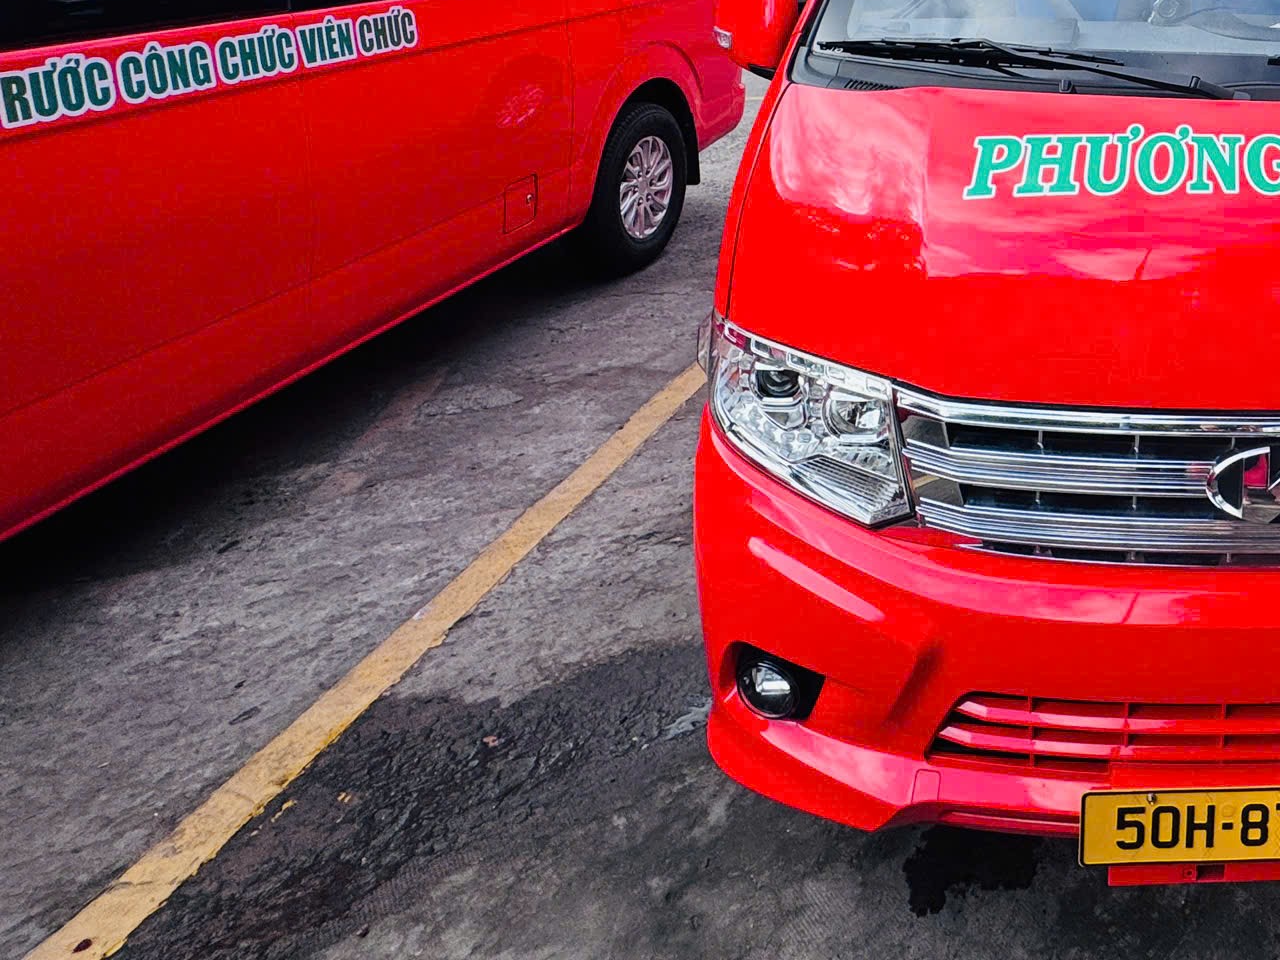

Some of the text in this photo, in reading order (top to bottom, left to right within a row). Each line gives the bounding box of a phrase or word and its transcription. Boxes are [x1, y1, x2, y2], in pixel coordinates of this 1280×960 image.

[0, 8, 417, 126] RƯỚC CÔNG CHỨC VIÊN CHỨC
